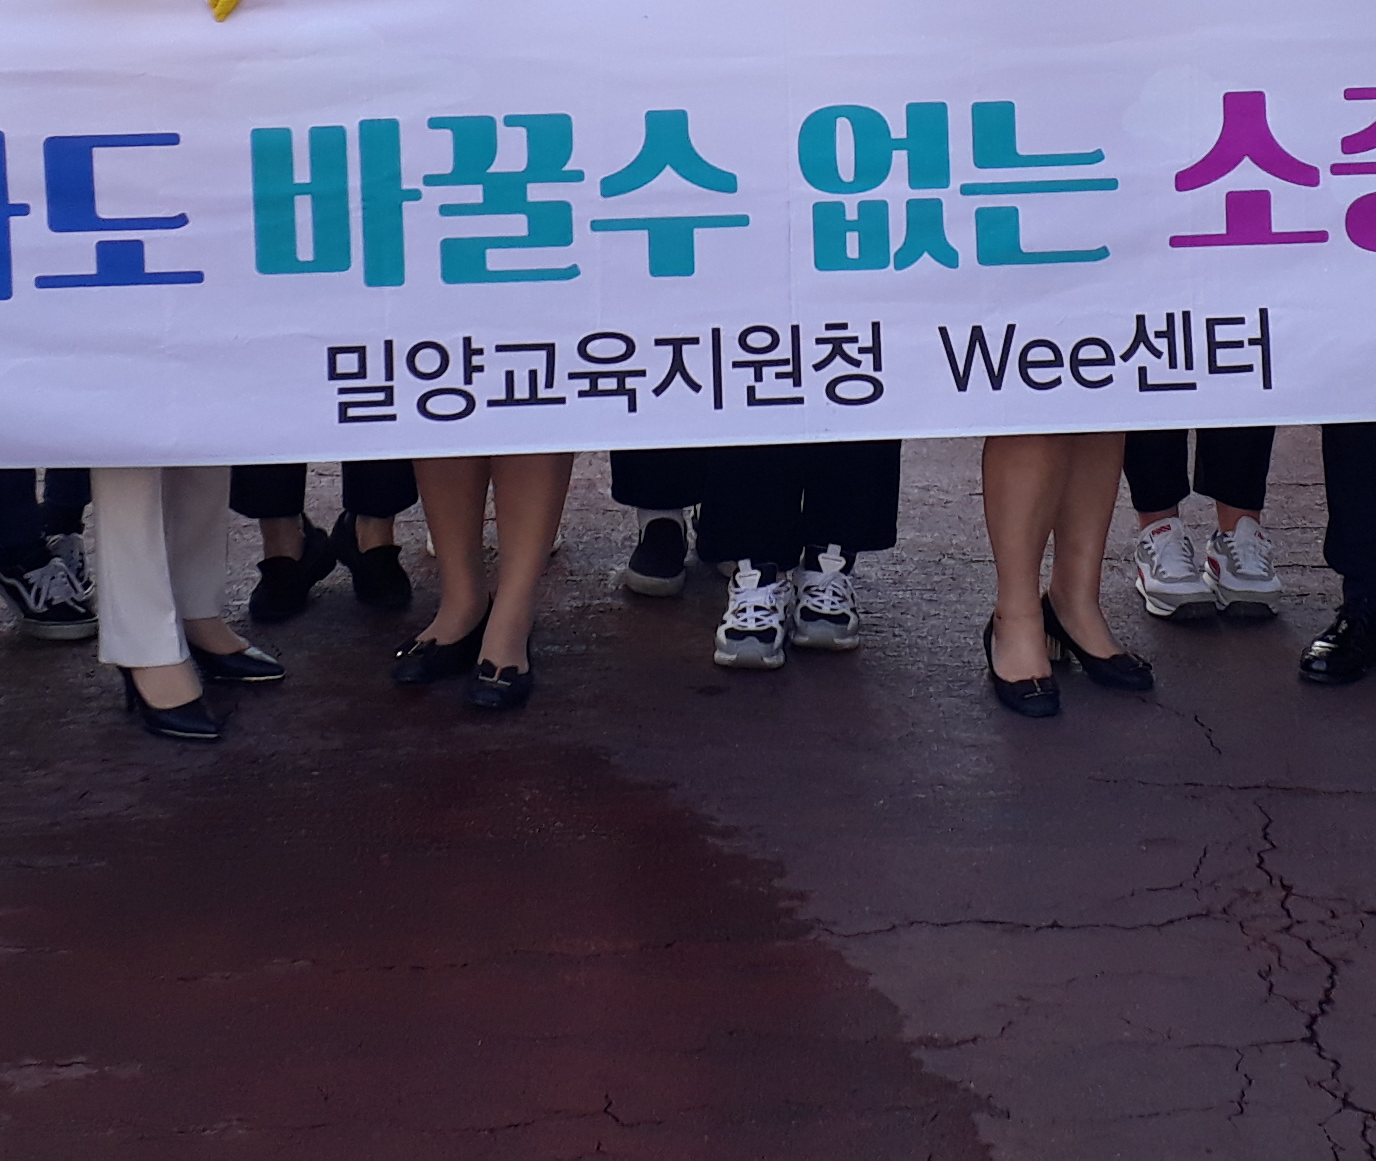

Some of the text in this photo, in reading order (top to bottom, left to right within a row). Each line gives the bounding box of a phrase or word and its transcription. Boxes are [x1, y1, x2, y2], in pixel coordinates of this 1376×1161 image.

[250, 108, 750, 288] 바꿀수
[797, 100, 1120, 273] 없는
[326, 307, 1275, 424] 밀양교육지원청 Wee센터
